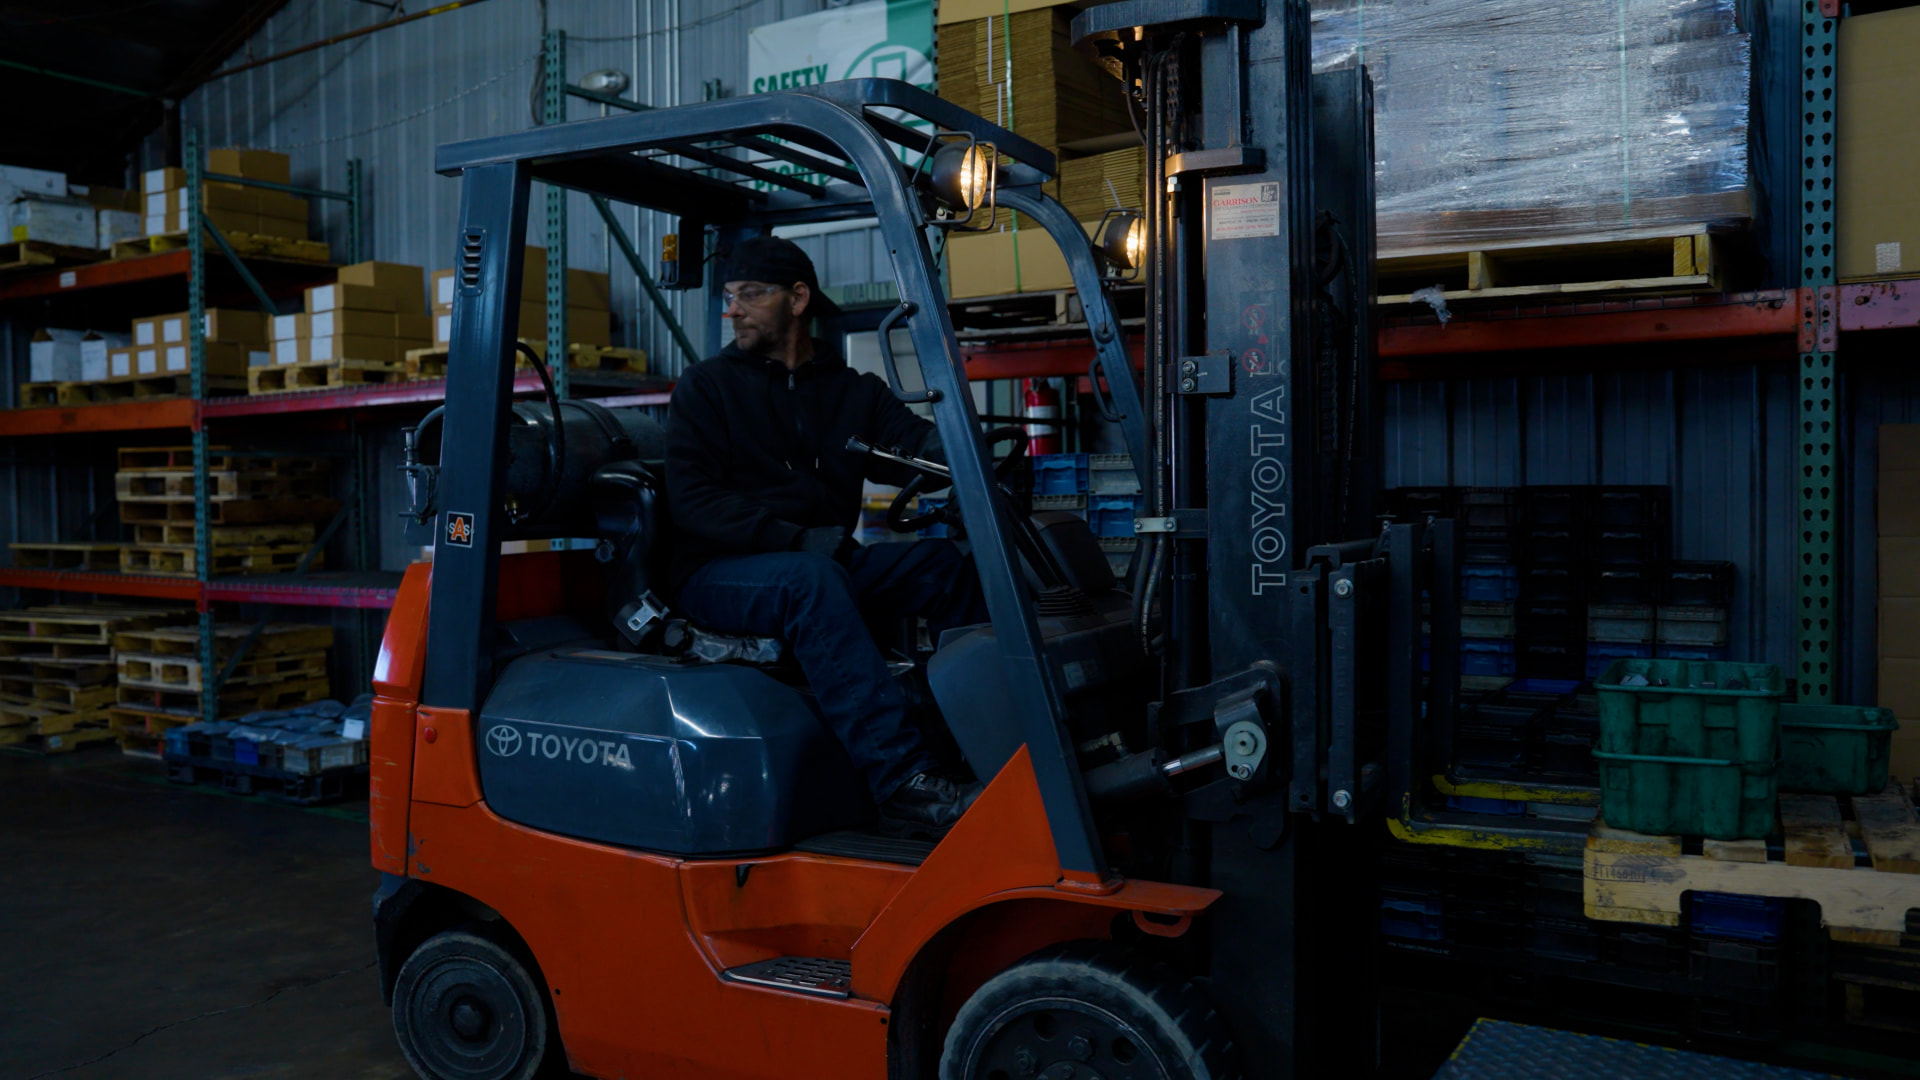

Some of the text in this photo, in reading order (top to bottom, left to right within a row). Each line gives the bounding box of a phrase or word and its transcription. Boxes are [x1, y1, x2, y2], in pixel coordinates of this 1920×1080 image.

[1213, 197, 1258, 206] GARRISON
[1251, 385, 1286, 596] TOYOTA
[527, 731, 632, 768] TOYOTA
